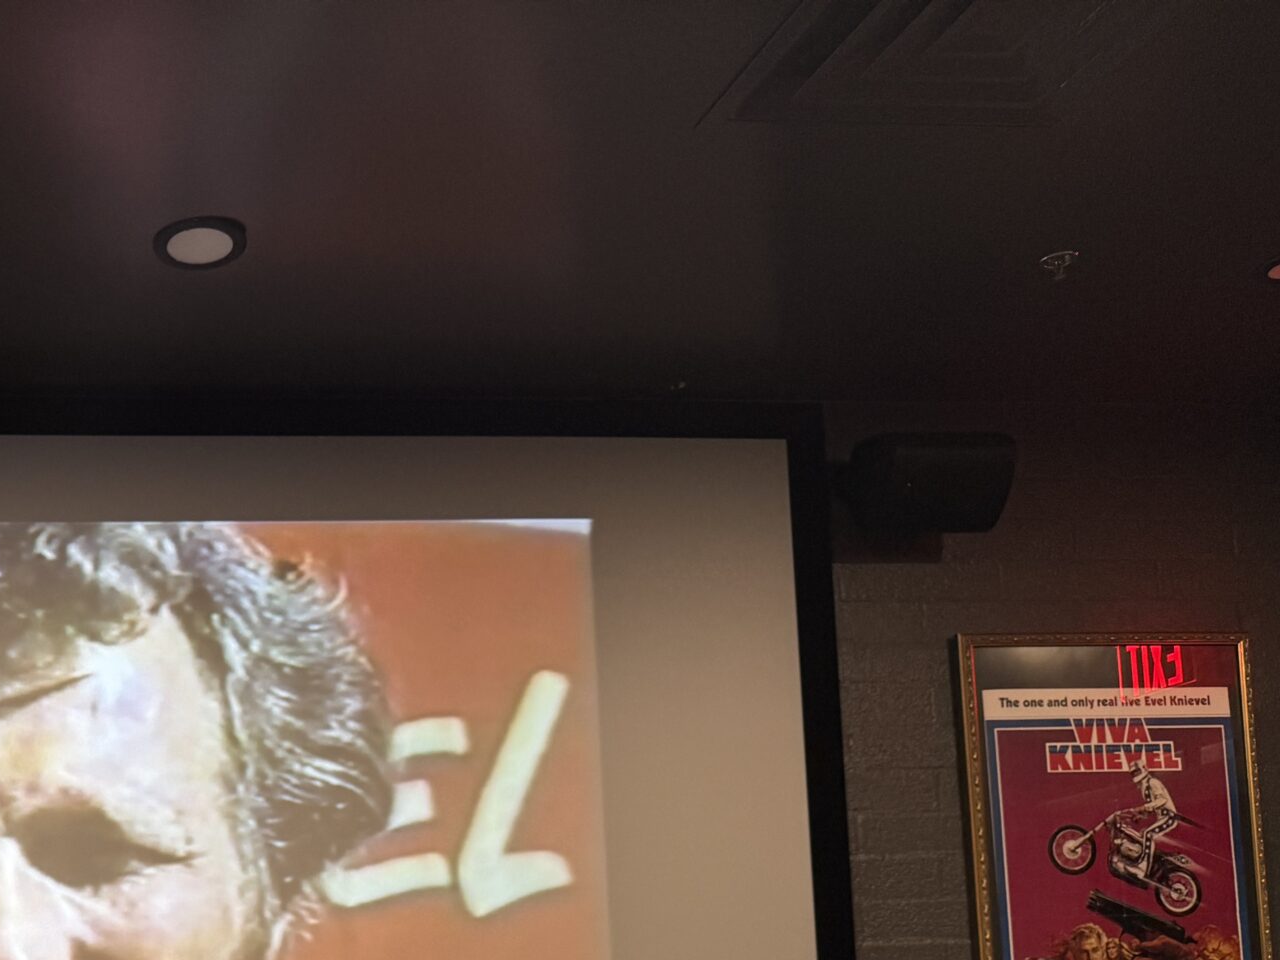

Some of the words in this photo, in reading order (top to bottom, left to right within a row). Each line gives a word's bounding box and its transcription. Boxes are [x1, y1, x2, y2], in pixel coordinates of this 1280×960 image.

[999, 697, 1020, 708] The
[1023, 698, 1044, 708] one
[1047, 696, 1068, 707] and
[1071, 696, 1094, 709] only
[1097, 696, 1118, 707] real
[1144, 696, 1167, 706] Evel
[1169, 695, 1211, 706] Knievel
[1070, 717, 1152, 744] VIVA
[1045, 741, 1182, 772] KNIEVEL
